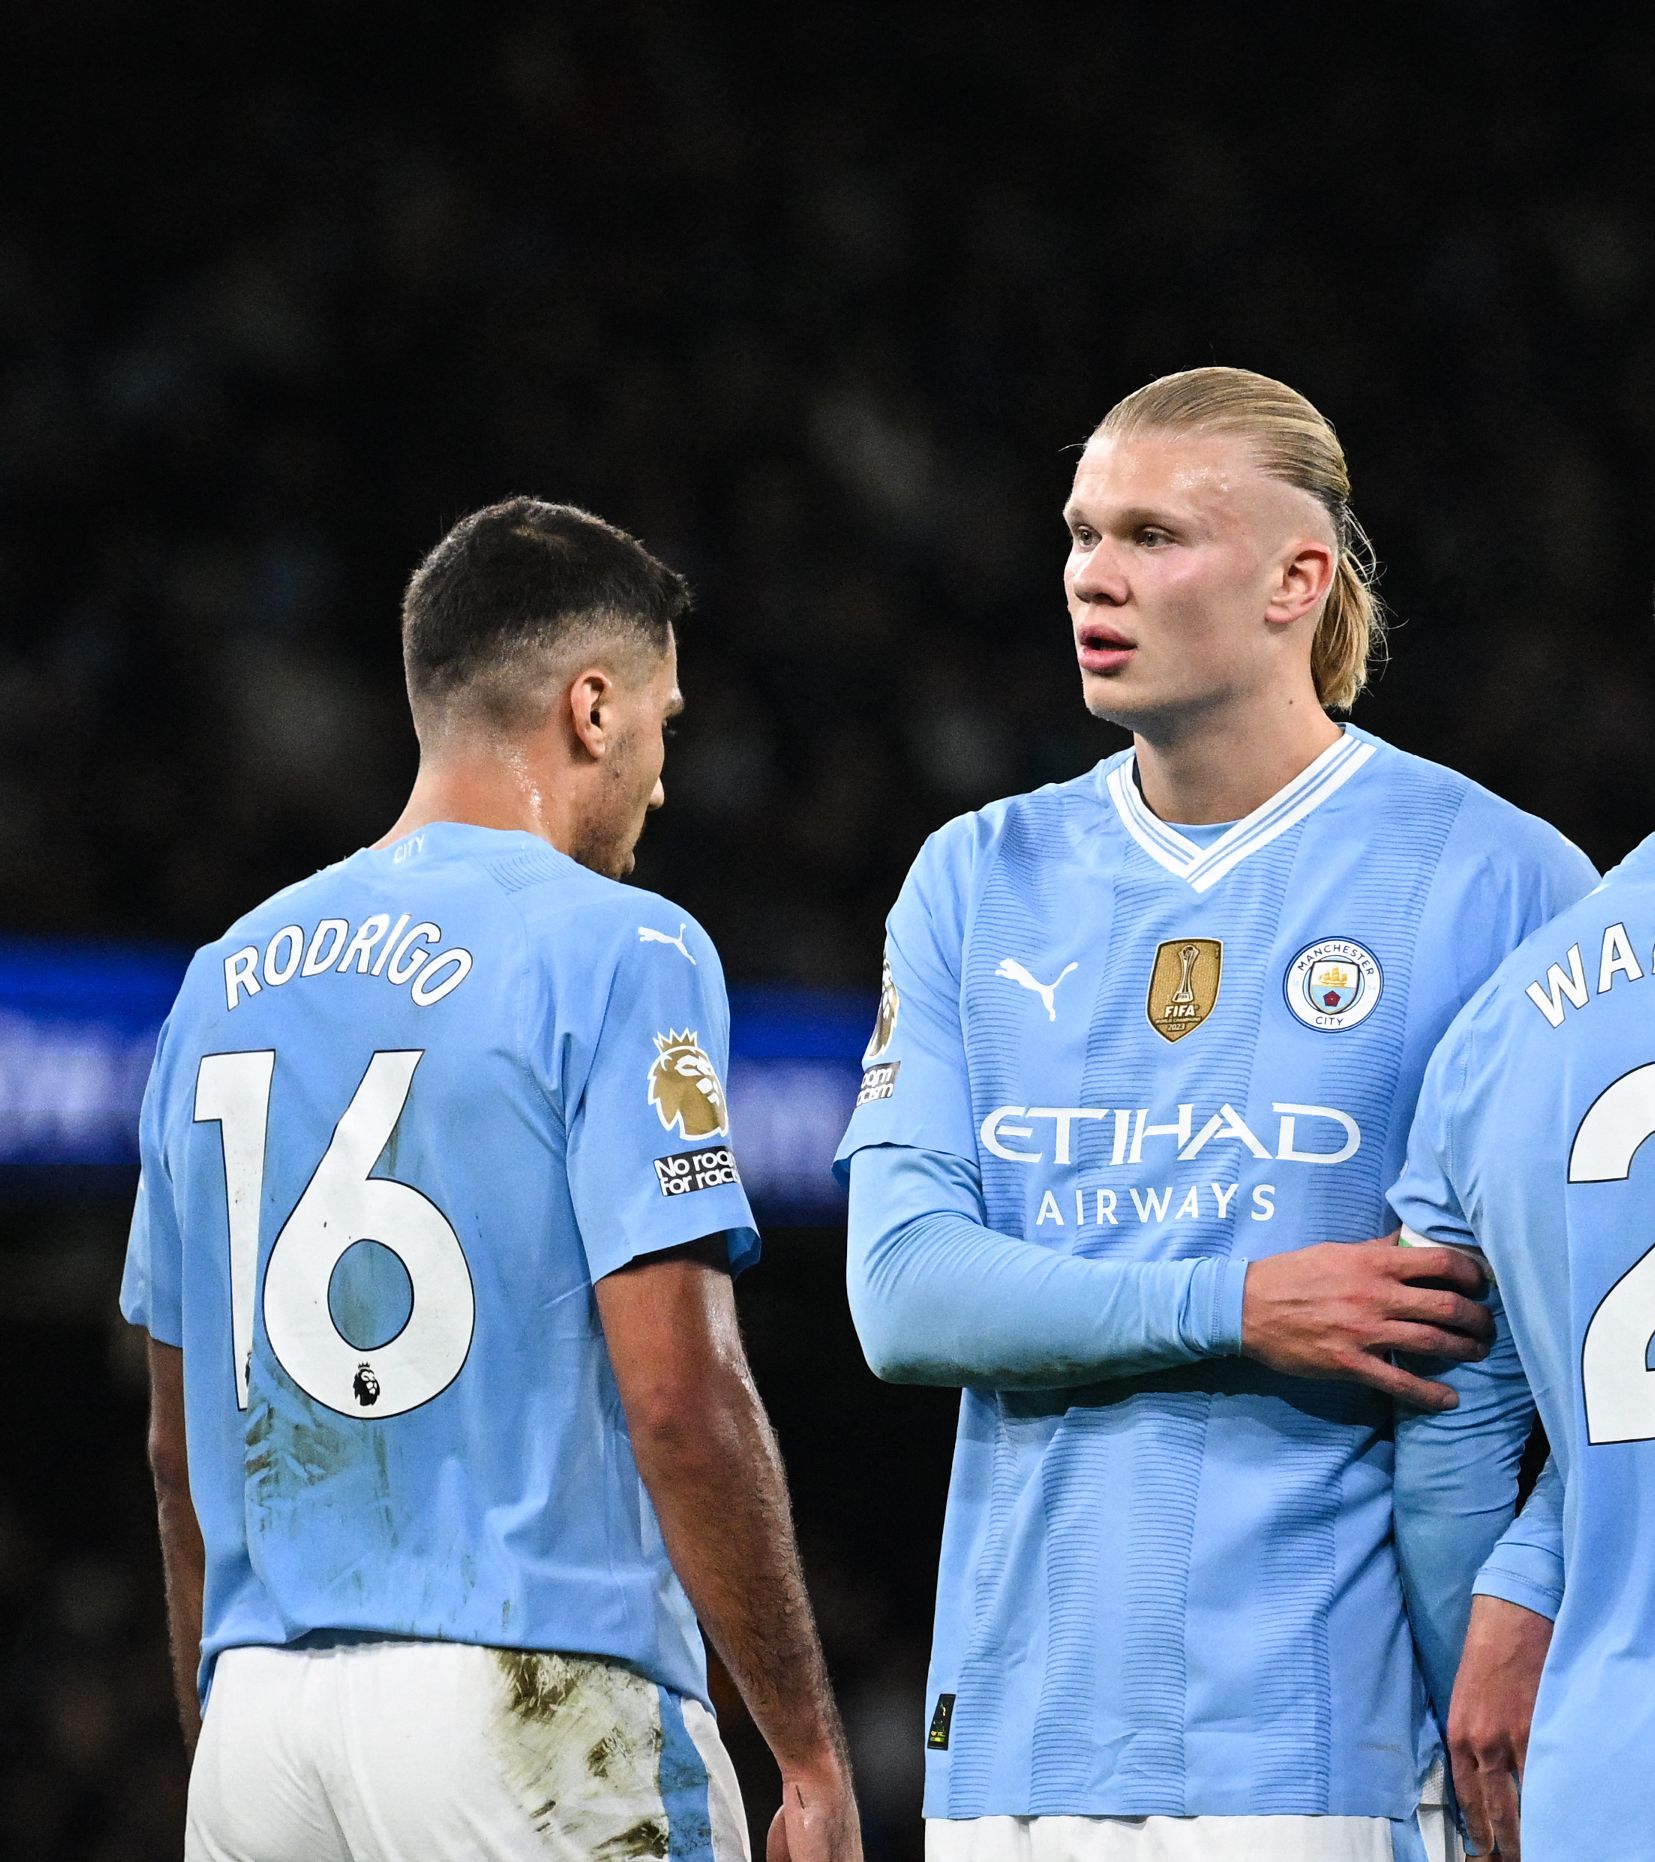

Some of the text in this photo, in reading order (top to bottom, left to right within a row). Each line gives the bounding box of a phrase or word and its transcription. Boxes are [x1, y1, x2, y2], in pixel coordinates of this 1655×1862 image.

[223, 912, 474, 1012] RODRIGO
[1297, 944, 1375, 976] MANCHESTER
[1164, 1005, 1195, 1018] FIFA
[1315, 1016, 1344, 1026] CITY
[980, 1102, 1361, 1165] ETIHAD
[653, 1156, 690, 1179] No
[660, 1175, 692, 1196] for
[1036, 1183, 1276, 1226] AIRWAYS
[193, 1048, 476, 1421] 16
